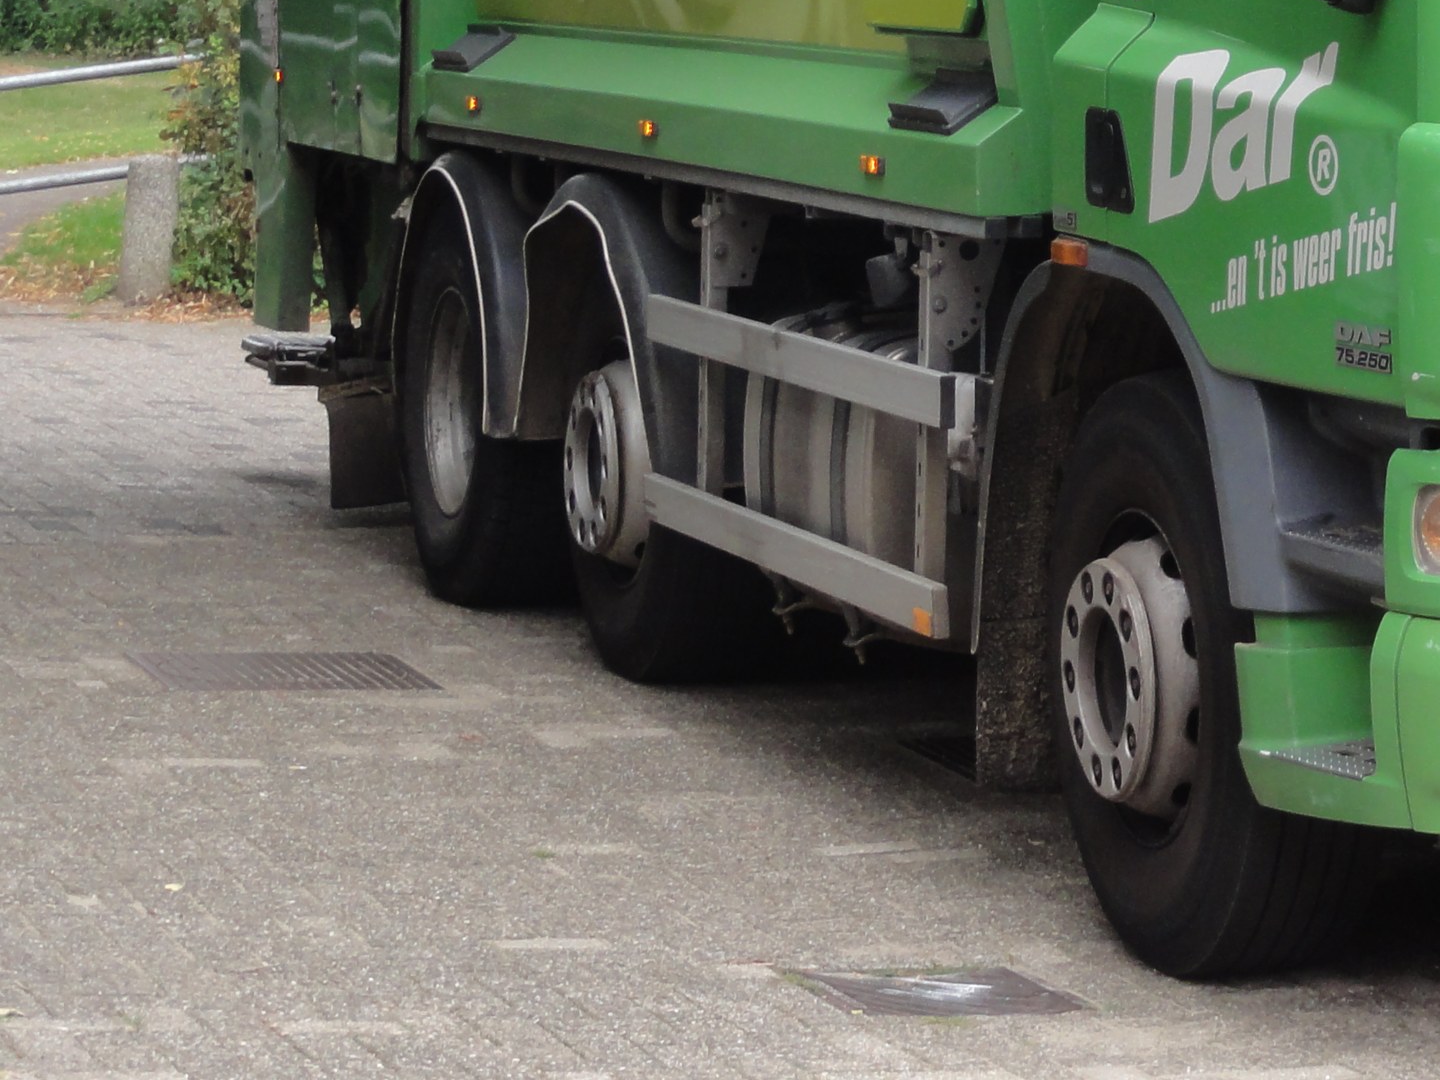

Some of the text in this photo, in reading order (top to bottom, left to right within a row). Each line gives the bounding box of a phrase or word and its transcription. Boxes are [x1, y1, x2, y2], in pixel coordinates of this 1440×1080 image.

[1148, 41, 1339, 224] Dar
[1270, 235, 1287, 297] is
[1293, 228, 1342, 291] weer
[1347, 202, 1397, 277] fris!
[1336, 347, 1391, 371] 75.250
[1338, 323, 1392, 348] DAF
